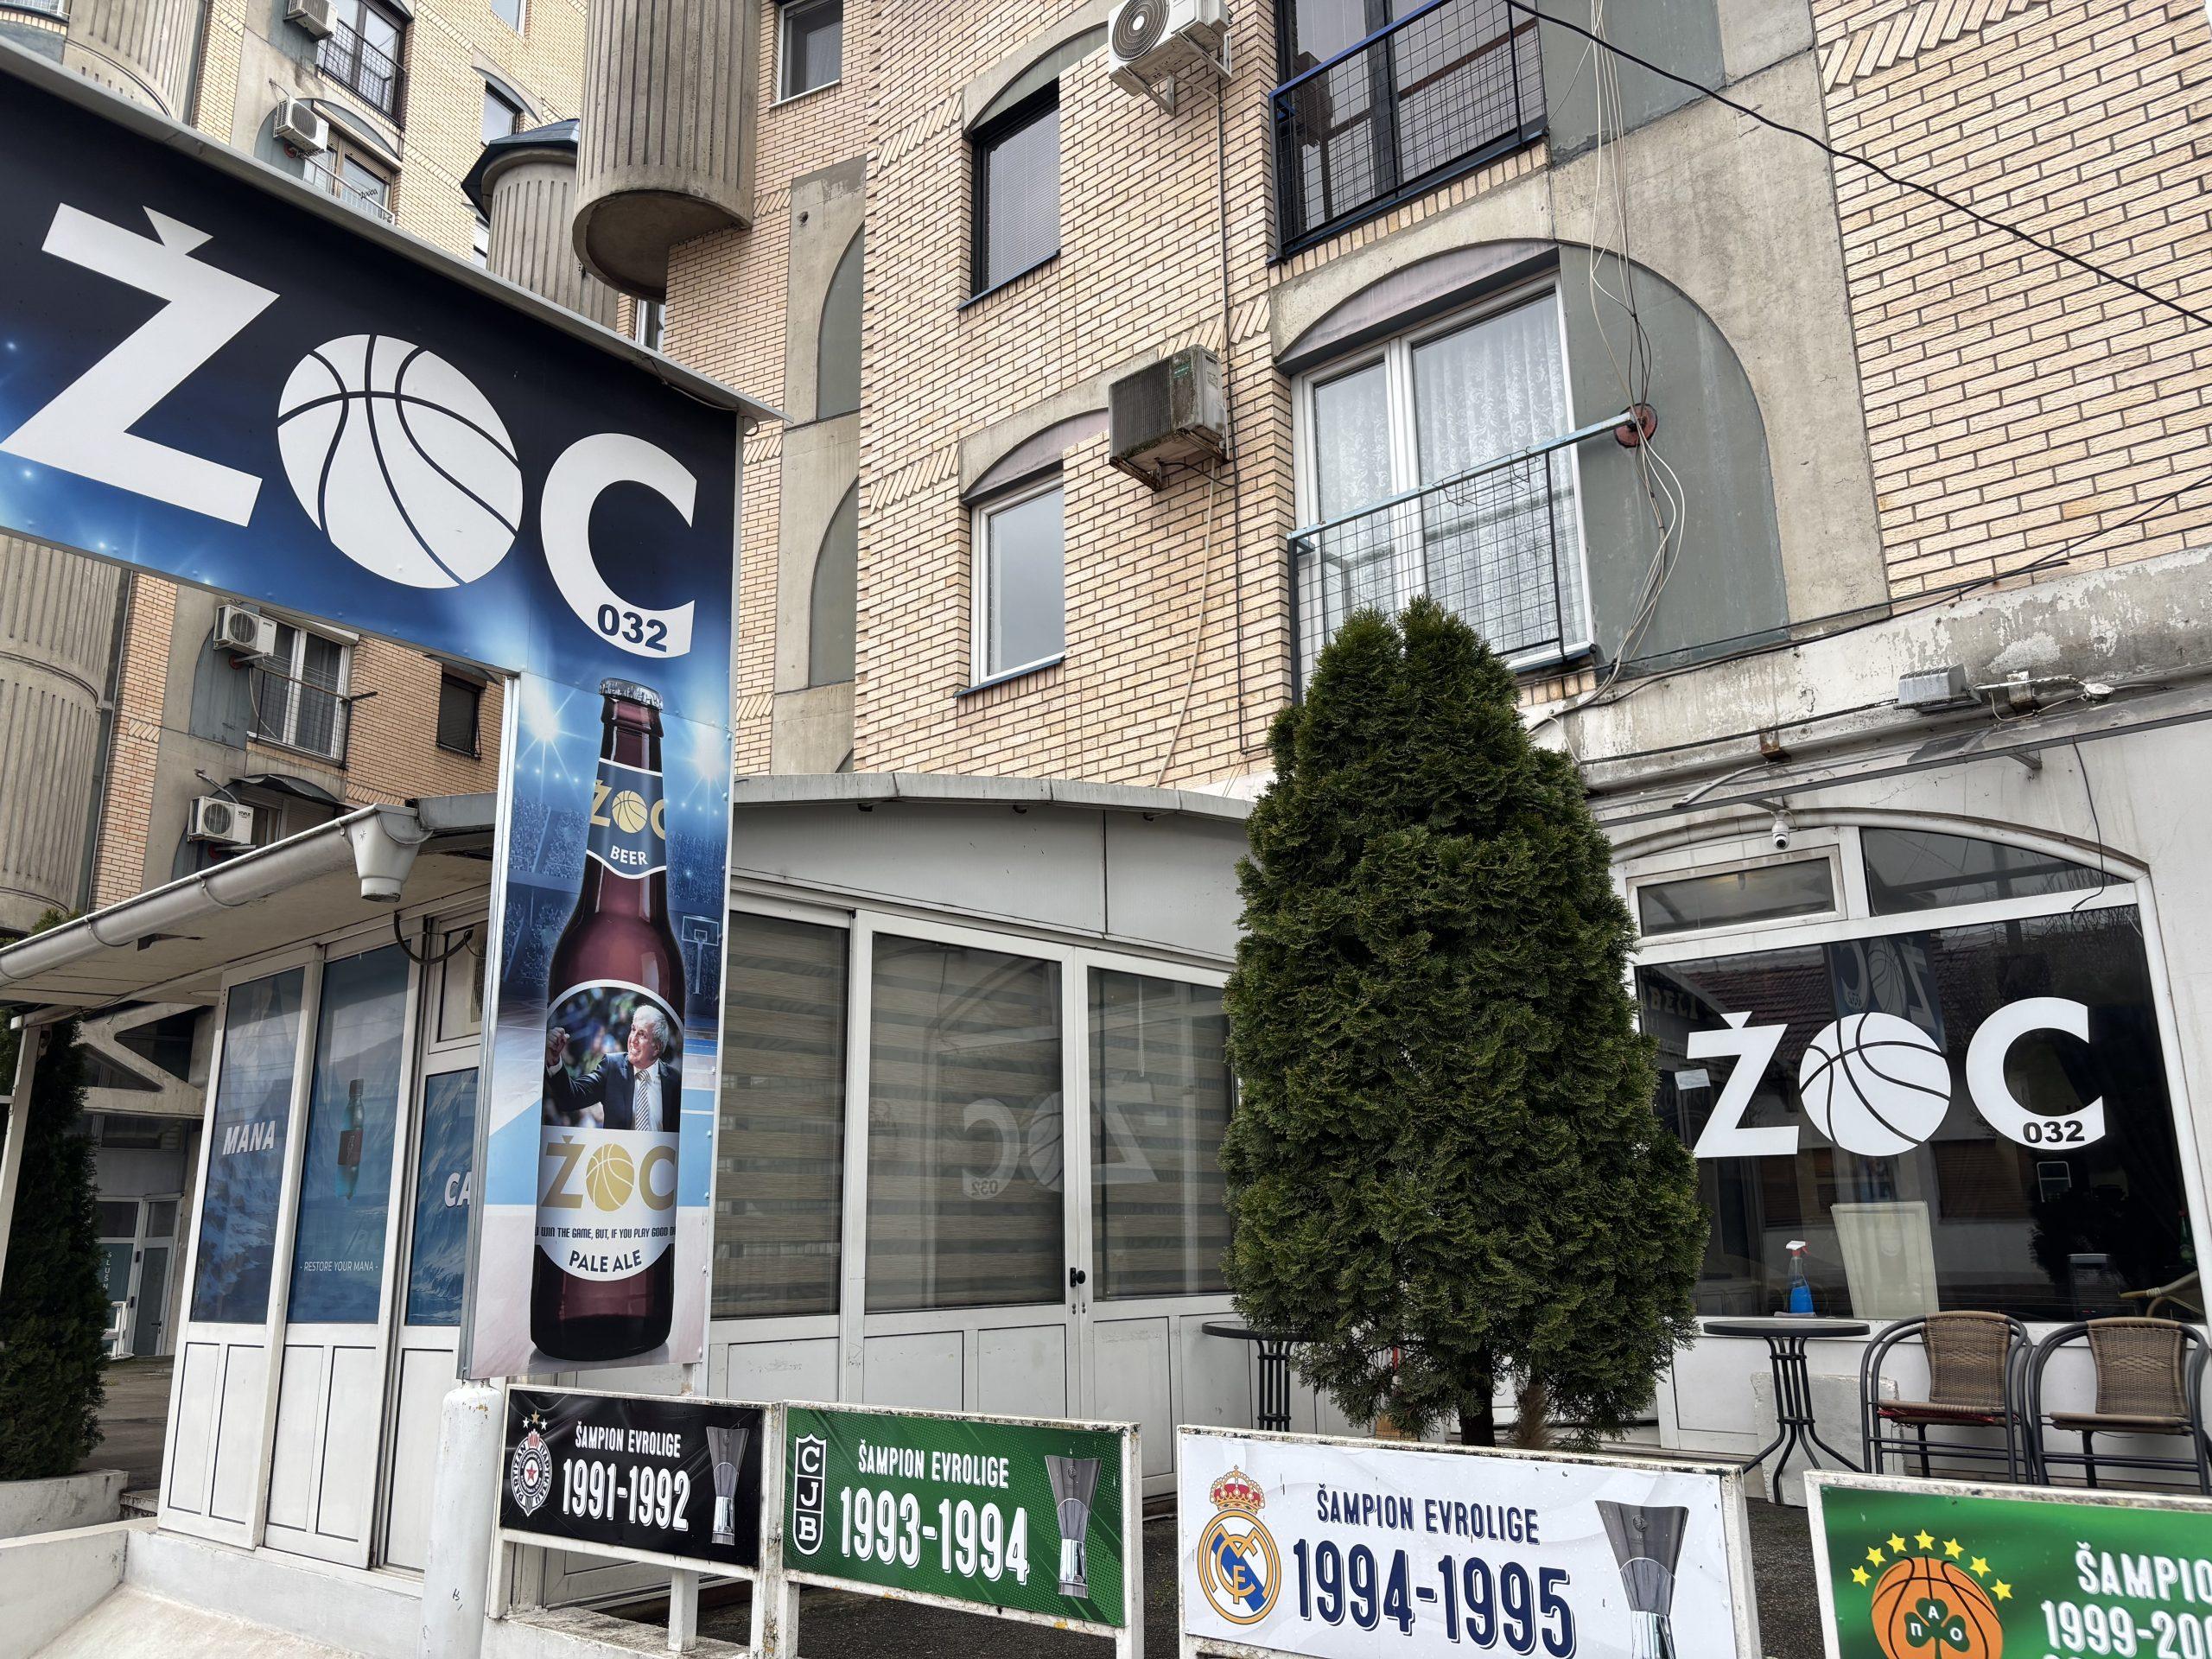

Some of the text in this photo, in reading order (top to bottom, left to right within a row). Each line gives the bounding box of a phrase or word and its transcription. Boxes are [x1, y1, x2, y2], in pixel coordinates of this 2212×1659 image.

[597, 604, 668, 652] 032
[610, 845, 649, 866] BEER
[222, 1121, 276, 1155] MANA
[2023, 1120, 2086, 1144] 032
[541, 1226, 556, 1237] WIN
[557, 1227, 570, 1238] THE
[572, 1228, 594, 1240] GAME,
[595, 1229, 609, 1240] BUT,
[611, 1229, 618, 1239] IF
[620, 1229, 632, 1239] YOU
[633, 1228, 651, 1238] PLAY
[652, 1227, 669, 1237] GOOD
[304, 1261, 374, 1272] RESTORE YOUR MANA
[569, 1249, 642, 1273] PALE ALE
[575, 1421, 681, 1459] ŠAMPION EVROLIGE
[858, 1439, 1009, 1489] ŠAMPION EVROLIGE
[563, 1459, 690, 1532] 1991-1992
[1317, 1483, 1541, 1545] ŠAMPION EVROLIGE
[840, 1486, 1029, 1586] 1993-1994
[1294, 1538, 1577, 1658] 1994-1995
